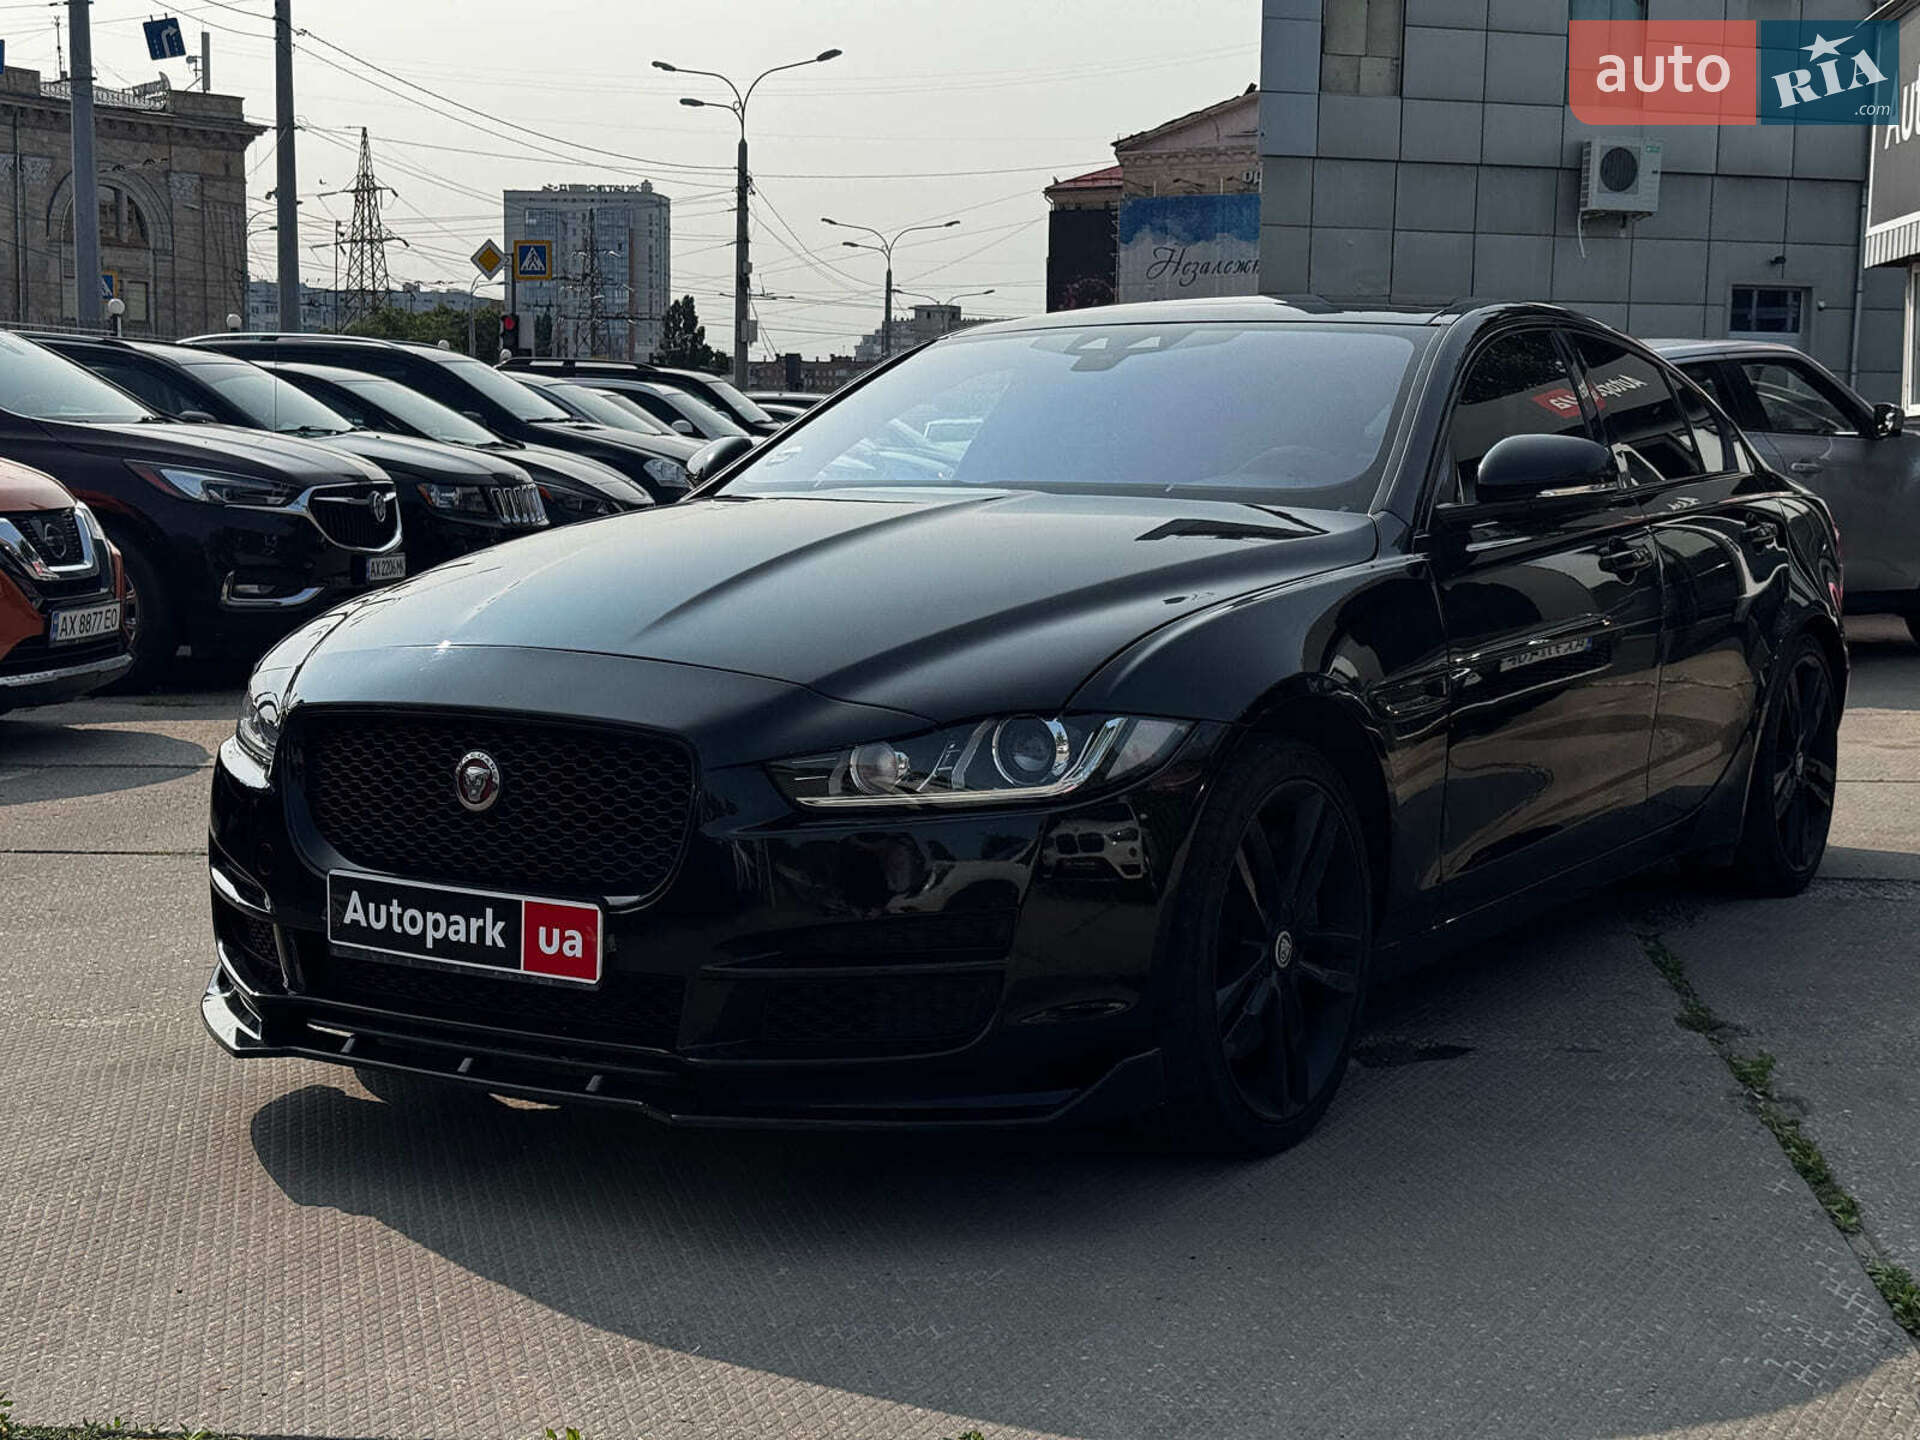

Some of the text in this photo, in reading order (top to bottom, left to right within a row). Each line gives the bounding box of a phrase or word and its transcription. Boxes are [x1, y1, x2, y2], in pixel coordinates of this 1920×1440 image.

[59, 607, 118, 637] AX 8877 EO
[343, 890, 583, 958] Autopark ua
